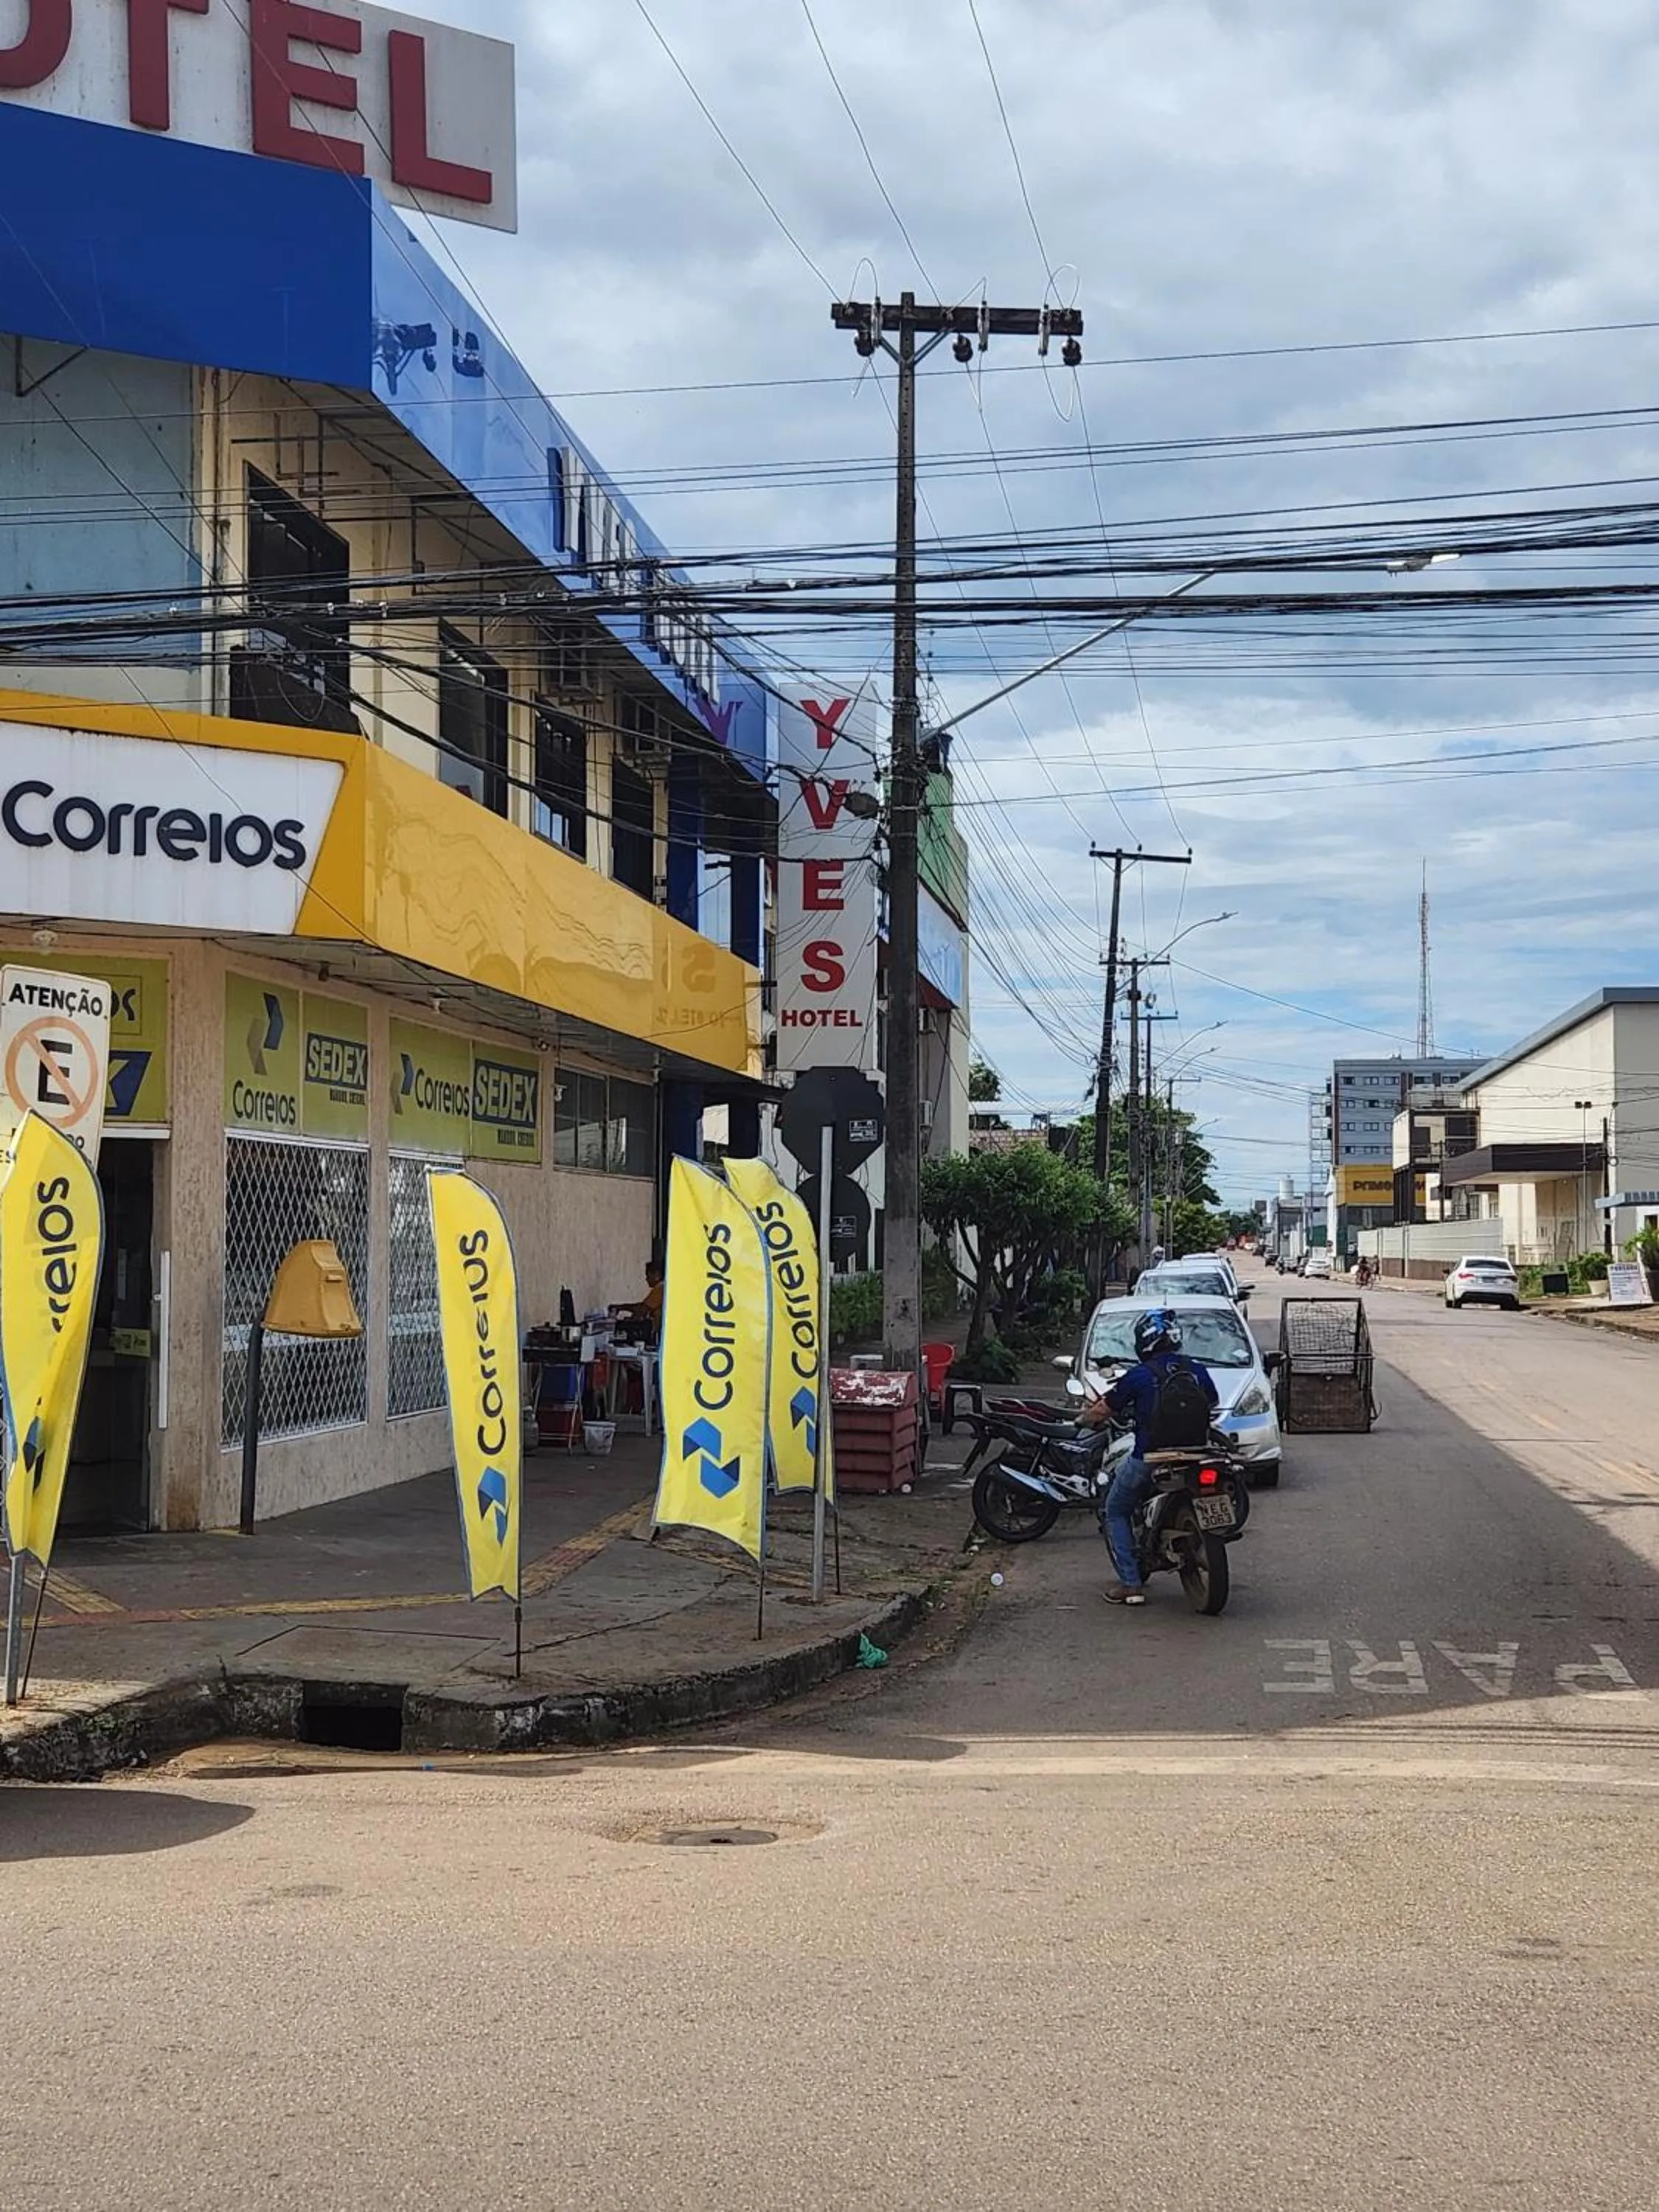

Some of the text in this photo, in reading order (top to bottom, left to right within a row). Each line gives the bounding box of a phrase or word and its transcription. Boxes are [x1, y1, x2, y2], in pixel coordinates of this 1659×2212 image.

[1, 780, 307, 870] Correios
[9, 982, 102, 1018] ATENÇÃO
[781, 1009, 863, 1028] HOTEL
[307, 1038, 367, 1087] SEDEX
[232, 1079, 296, 1125] Correios
[414, 1068, 470, 1117] Correios
[474, 1065, 537, 1123] SEDEX
[757, 1201, 819, 1379] Correios
[695, 1223, 736, 1411] Correios
[1262, 1638, 1650, 1702] PARE
